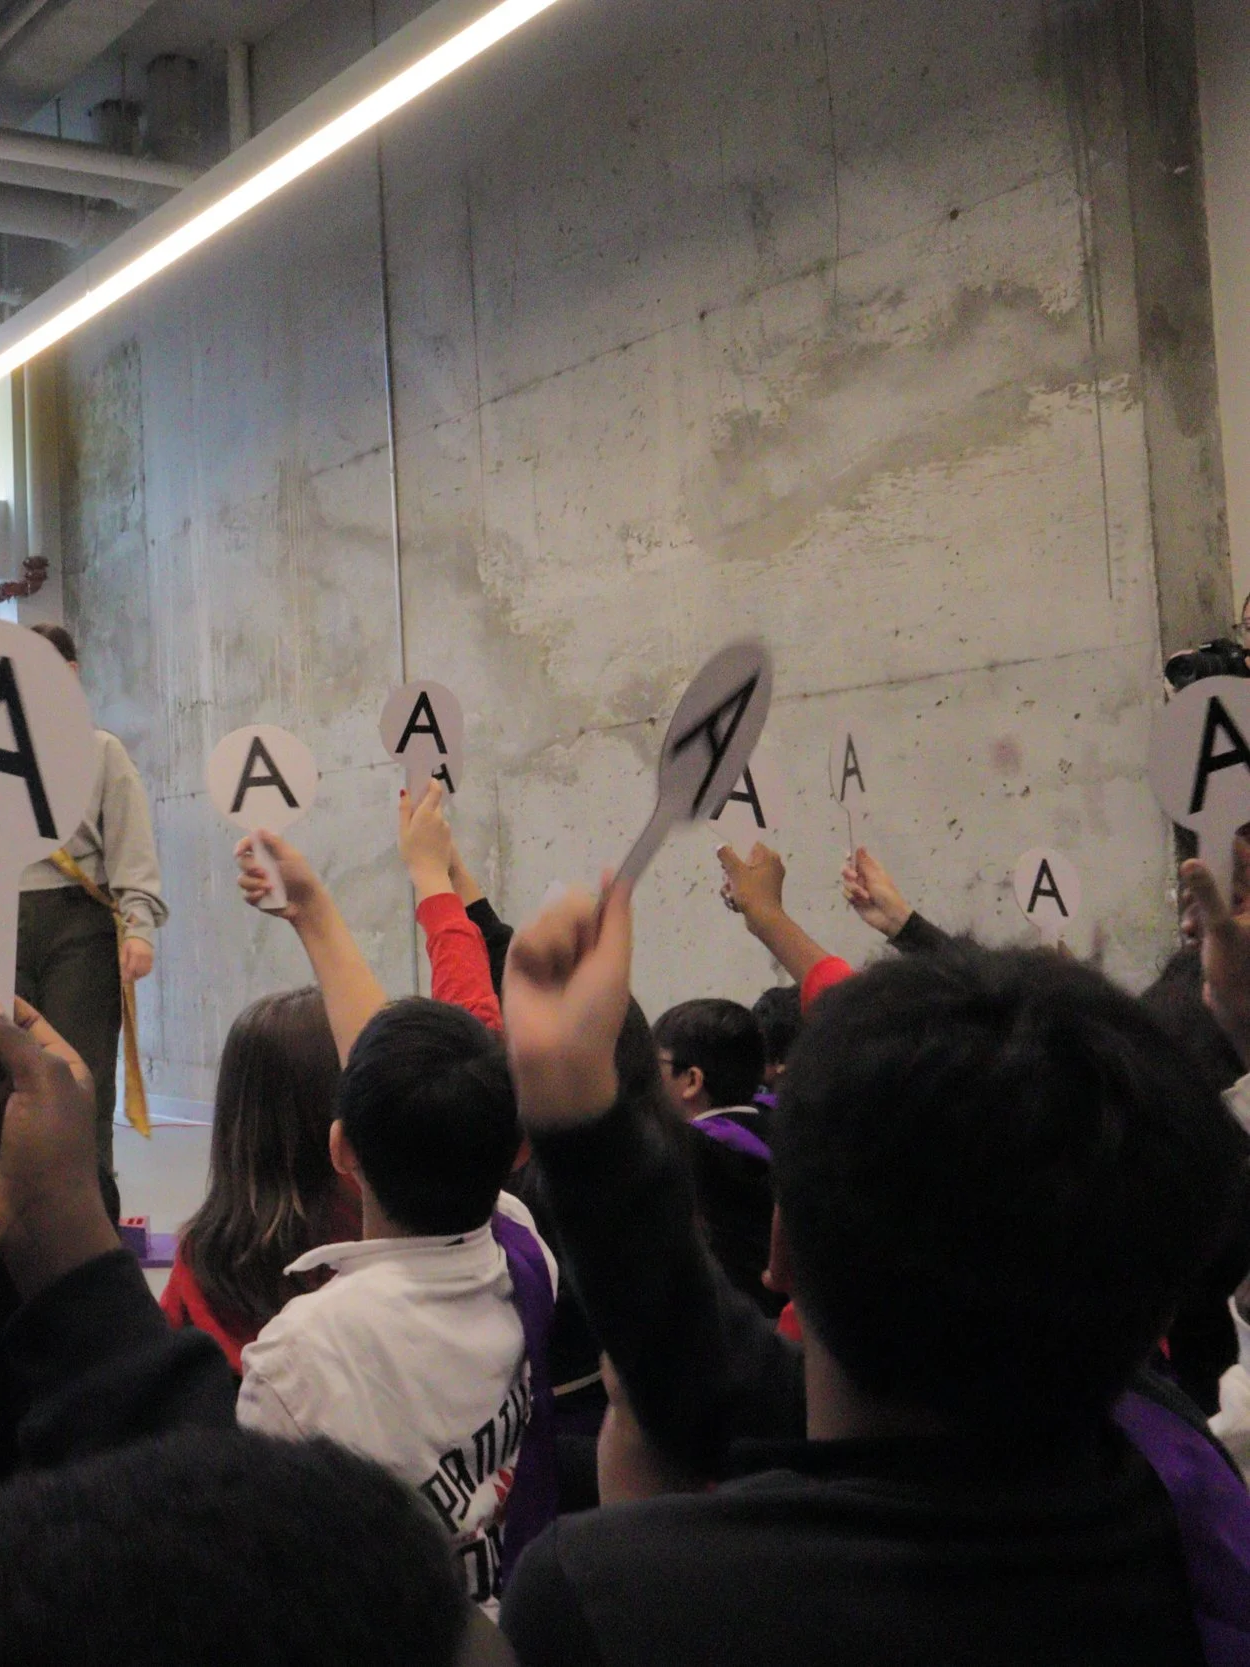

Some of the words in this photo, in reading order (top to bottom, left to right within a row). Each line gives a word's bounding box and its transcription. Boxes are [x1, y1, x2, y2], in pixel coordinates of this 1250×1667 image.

[395, 690, 448, 754] A
[672, 670, 761, 820] A
[1187, 695, 1250, 815] A
[230, 735, 300, 813] A
[709, 762, 767, 829] A
[840, 732, 866, 801] A
[1026, 858, 1069, 918] A
